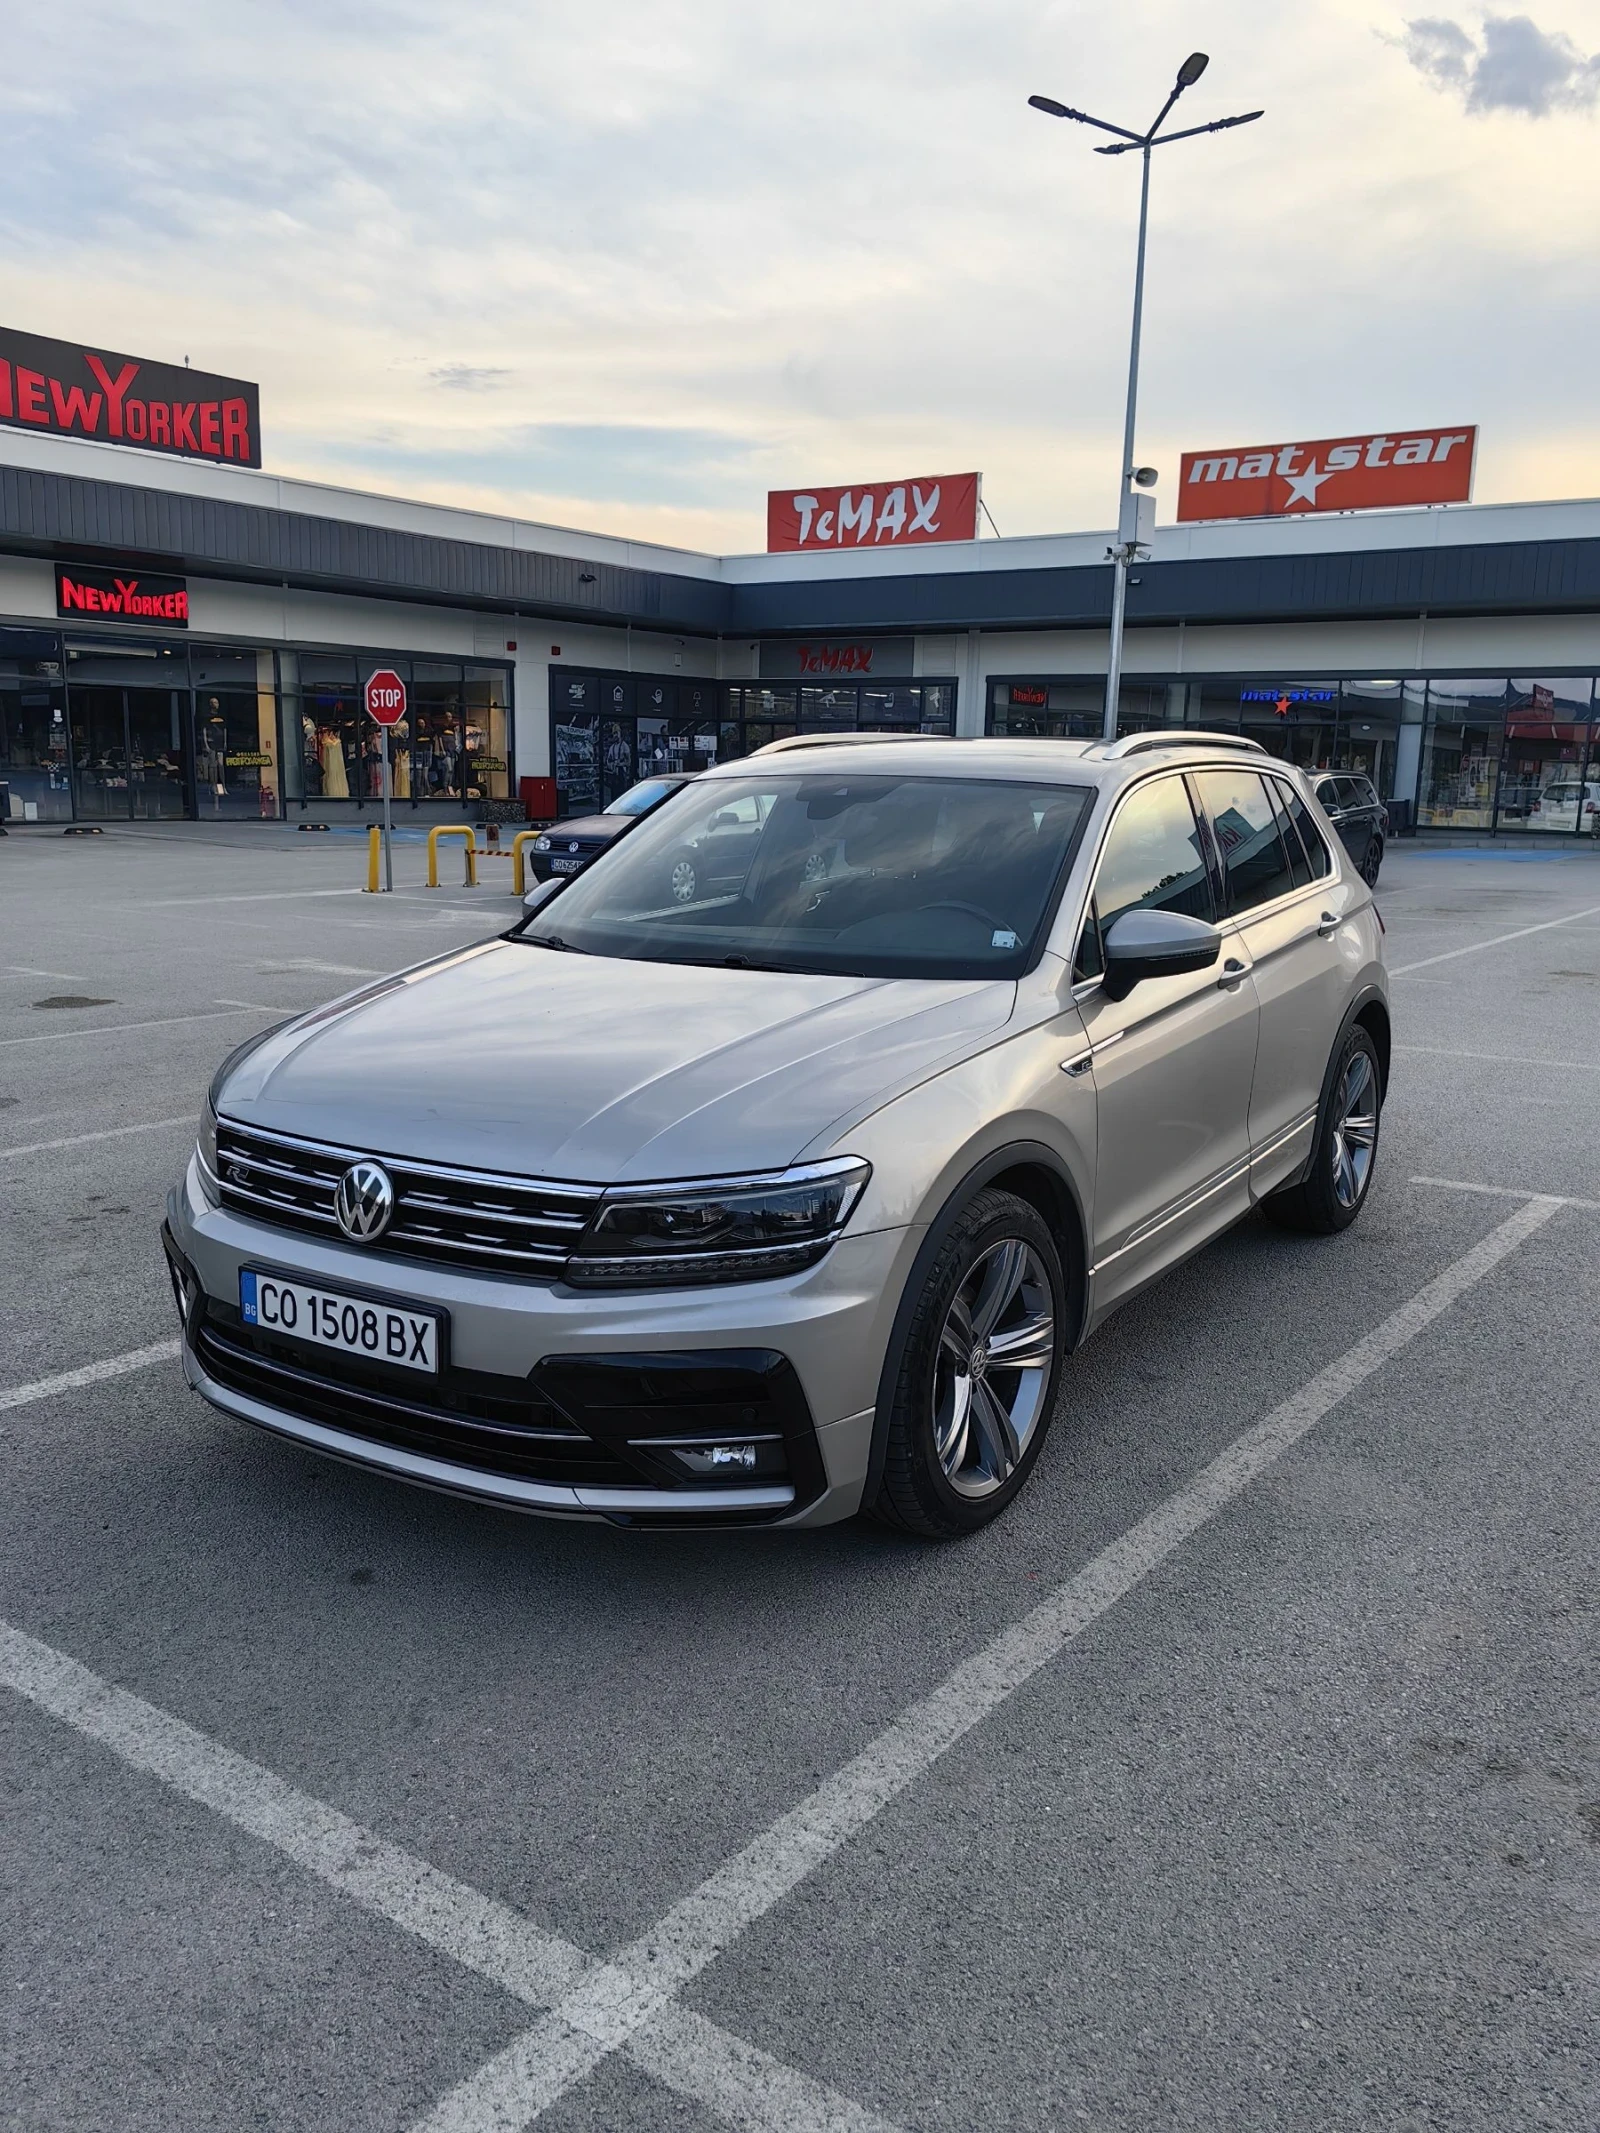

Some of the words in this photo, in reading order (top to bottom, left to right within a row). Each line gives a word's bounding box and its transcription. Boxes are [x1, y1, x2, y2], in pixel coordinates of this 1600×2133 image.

[0, 354, 250, 461] EWYORKER
[1188, 446, 1304, 484] mat
[1324, 434, 1468, 472] star
[371, 688, 401, 708] STOP
[244, 1302, 257, 1317] BG
[261, 1283, 298, 1329] CO
[307, 1295, 379, 1351] 1508
[386, 1313, 430, 1365] BX
